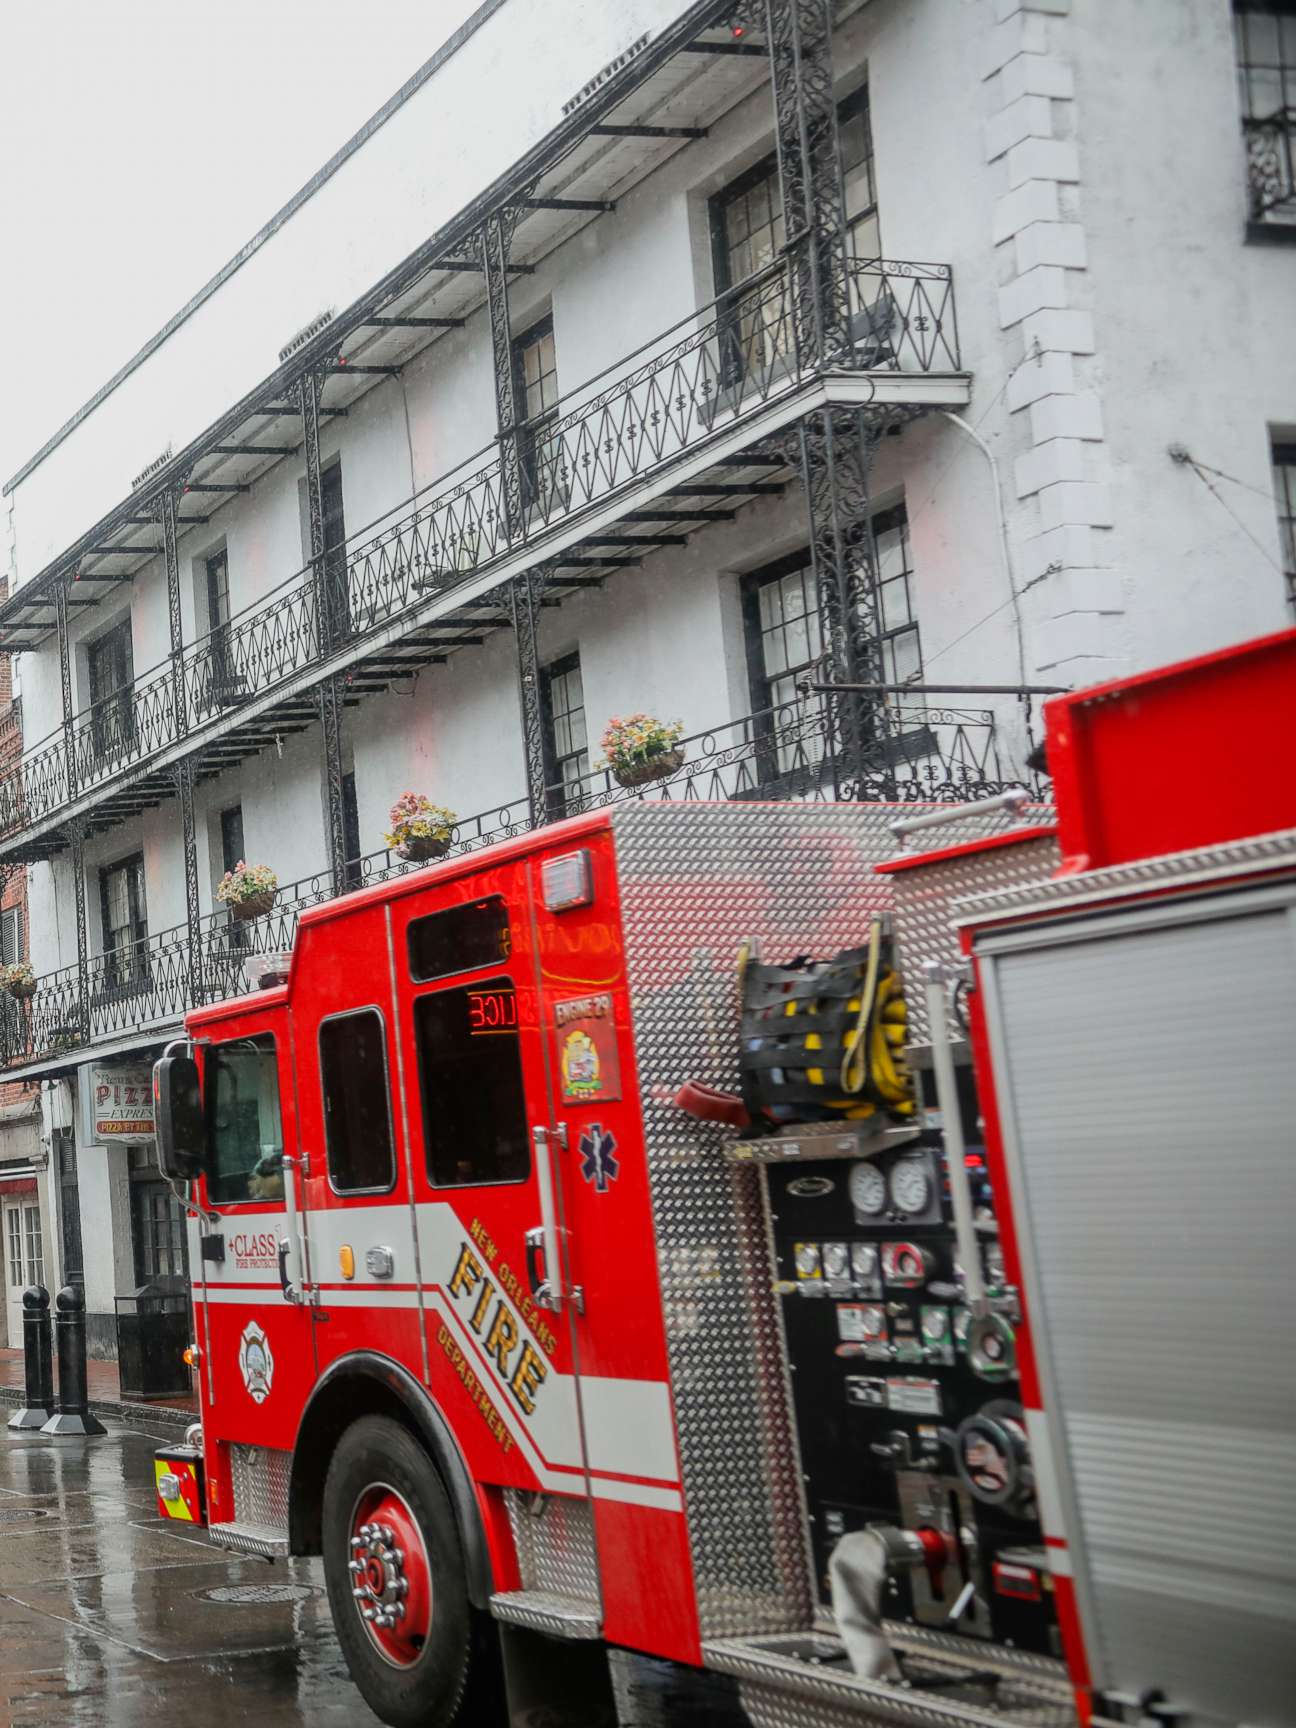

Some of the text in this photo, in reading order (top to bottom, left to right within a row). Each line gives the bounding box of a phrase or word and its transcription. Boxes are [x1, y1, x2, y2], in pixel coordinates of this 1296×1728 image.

[96, 1085, 153, 1106] PIZZ
[111, 1108, 153, 1119] EXPRES
[234, 1233, 276, 1258] CLASS
[470, 1217, 557, 1356] NEW ORLEANS
[447, 1241, 548, 1417] FIRE
[437, 1326, 515, 1455] DEPARTMENT
